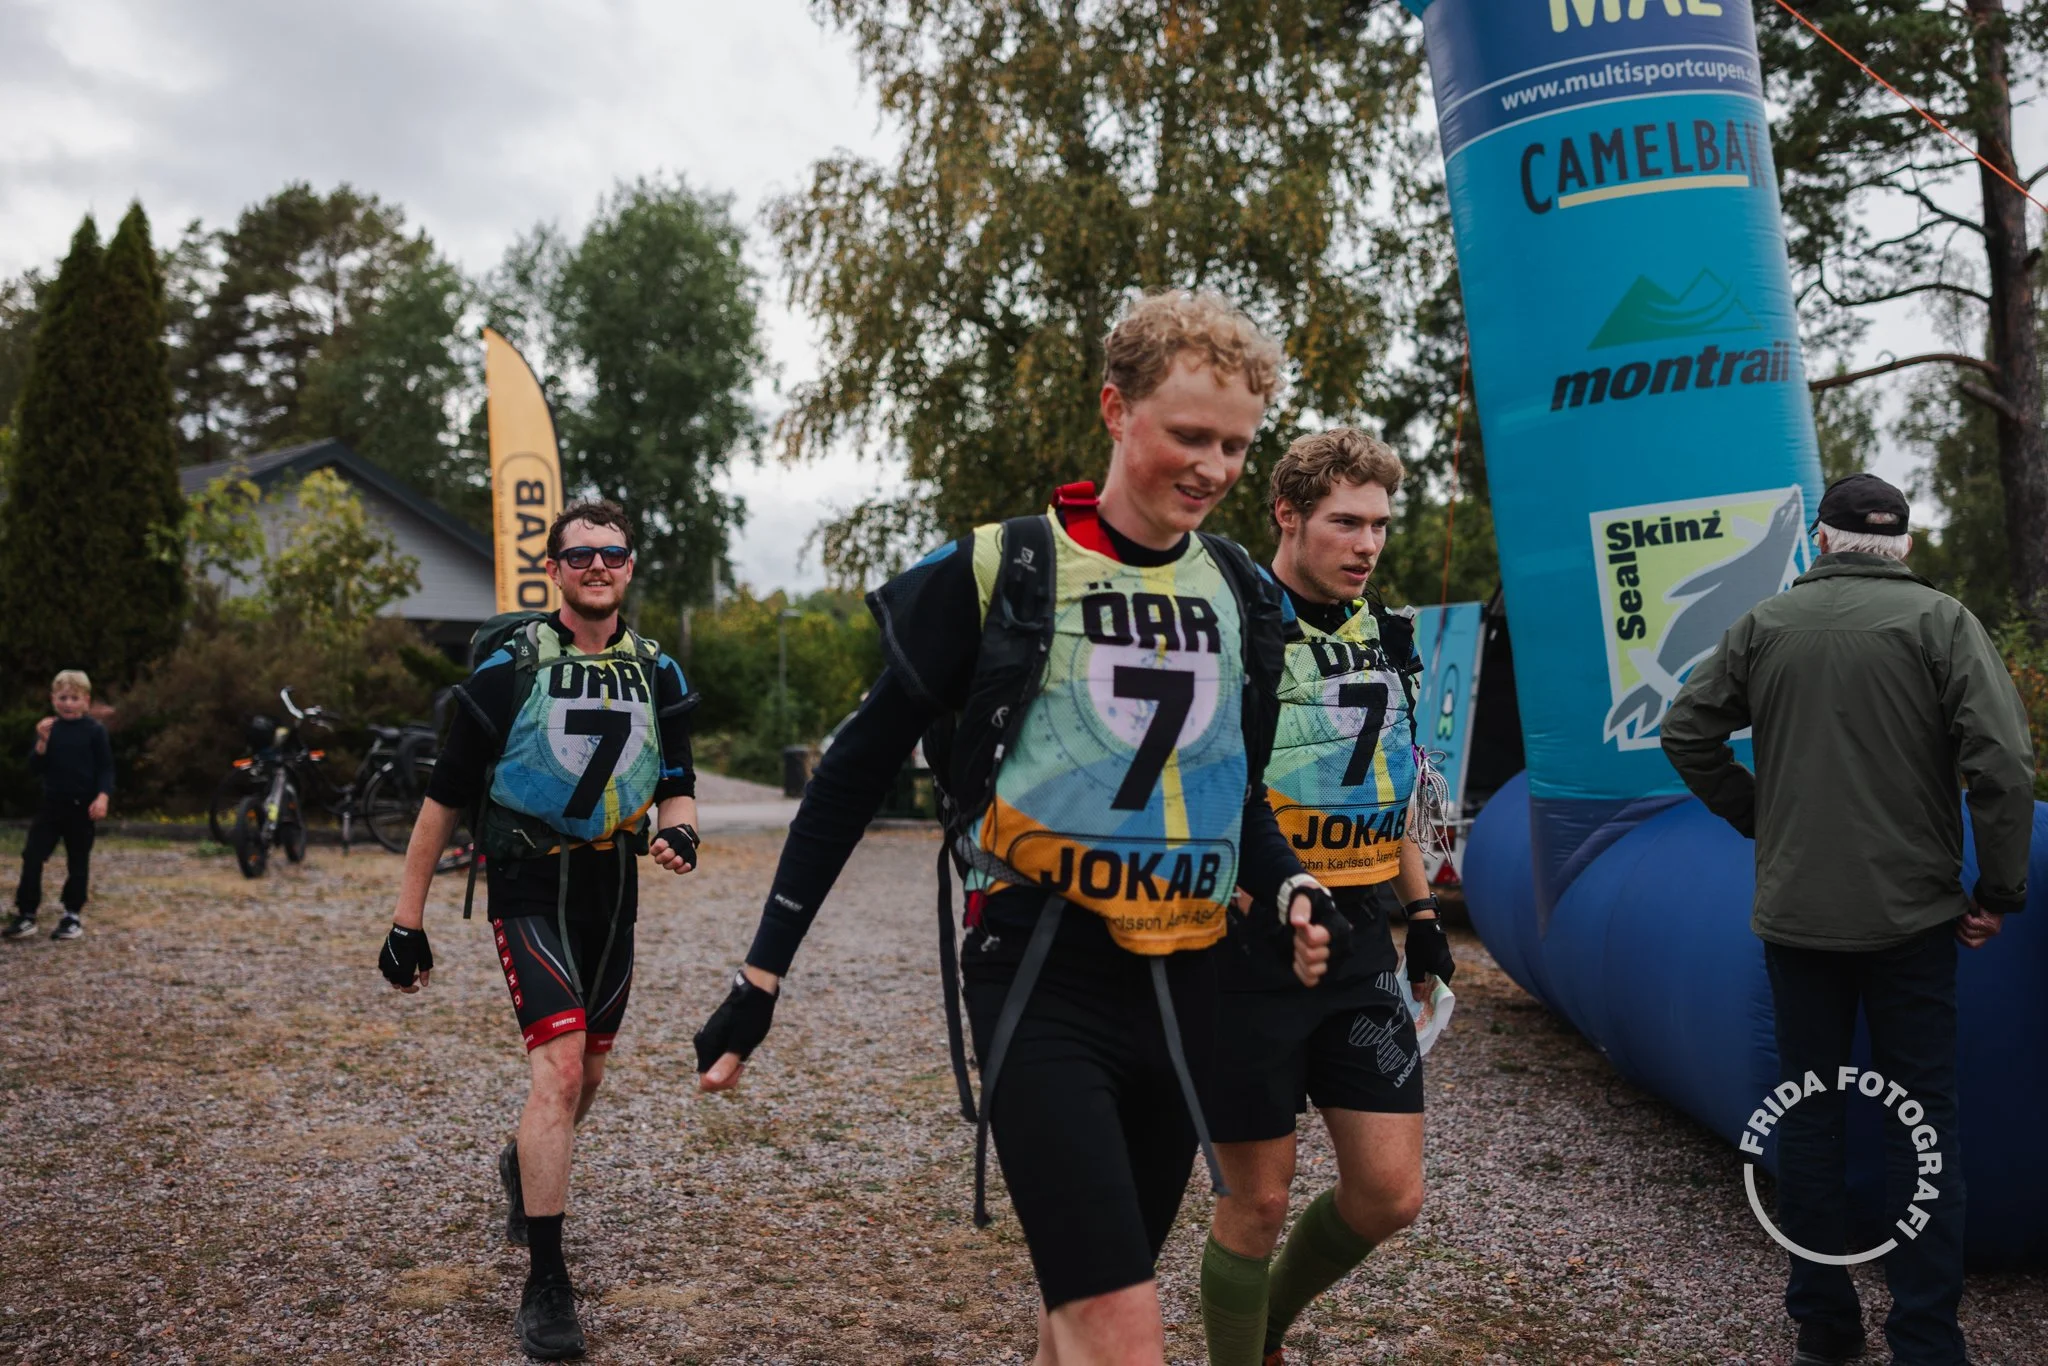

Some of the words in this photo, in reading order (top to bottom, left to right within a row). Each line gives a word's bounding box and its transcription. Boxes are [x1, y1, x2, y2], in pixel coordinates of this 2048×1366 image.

[1501, 59, 1756, 110] www.multisportcupen.s
[1551, 341, 1789, 412] montrail
[1082, 581, 1221, 654] ÖAR
[1609, 551, 1646, 641] Seal
[562, 709, 632, 820] 7
[1110, 665, 1195, 811] 7
[1339, 683, 1389, 787] 7
[1292, 806, 1407, 850] JOKAB
[1040, 847, 1221, 901] JOKAB
